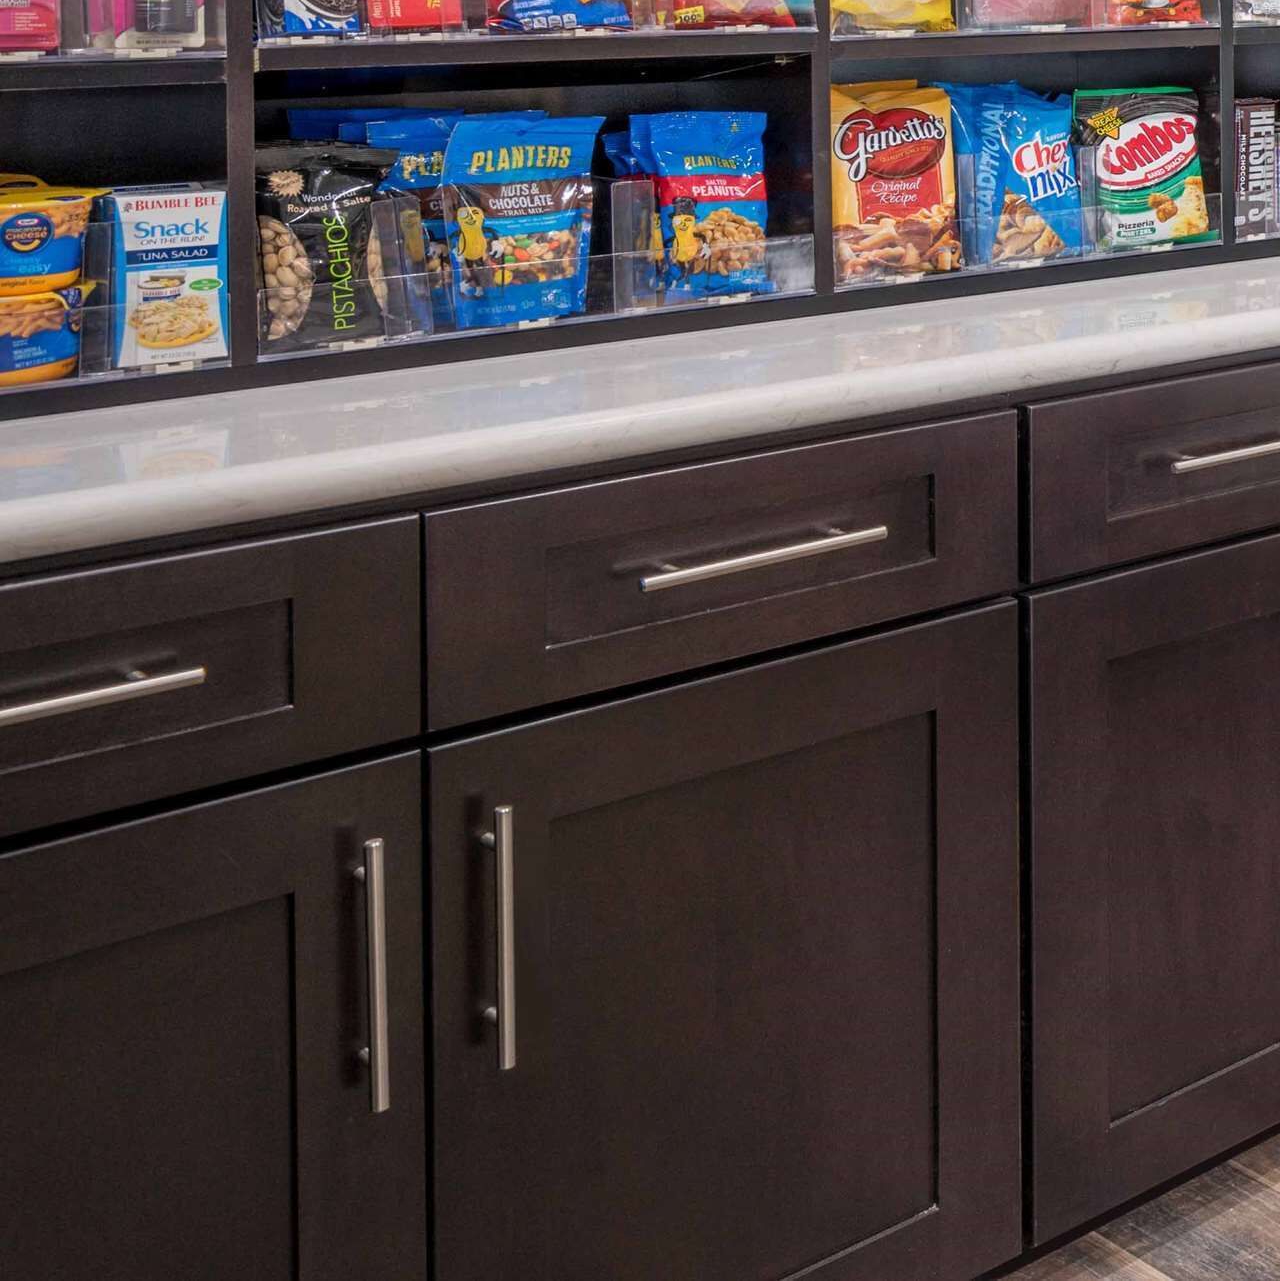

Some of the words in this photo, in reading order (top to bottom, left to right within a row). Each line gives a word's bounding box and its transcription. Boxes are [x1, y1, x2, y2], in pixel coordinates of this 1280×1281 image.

[834, 112, 946, 182] Gardetto's
[1103, 117, 1196, 175] Combos
[470, 144, 571, 175] PLANTERS
[684, 155, 737, 169] PLANTERS
[977, 103, 1005, 228] TRADITIONAL
[1249, 110, 1276, 222] HERSHEY'S
[500, 182, 529, 197] NUTS
[692, 186, 741, 198] PEANUTS
[871, 179, 921, 195] Original
[135, 198, 190, 212] BUMBLE
[195, 196, 217, 207] BEE
[489, 193, 554, 210] CHOCOLATE
[878, 191, 918, 205] Recipe
[134, 219, 209, 239] Snack
[1118, 220, 1155, 230] Pizzeria
[140, 238, 157, 246] ON
[159, 237, 177, 245] THE
[137, 251, 168, 262] TUNA
[171, 248, 208, 258] SALAD
[324, 215, 356, 330] PISTACHIOS
